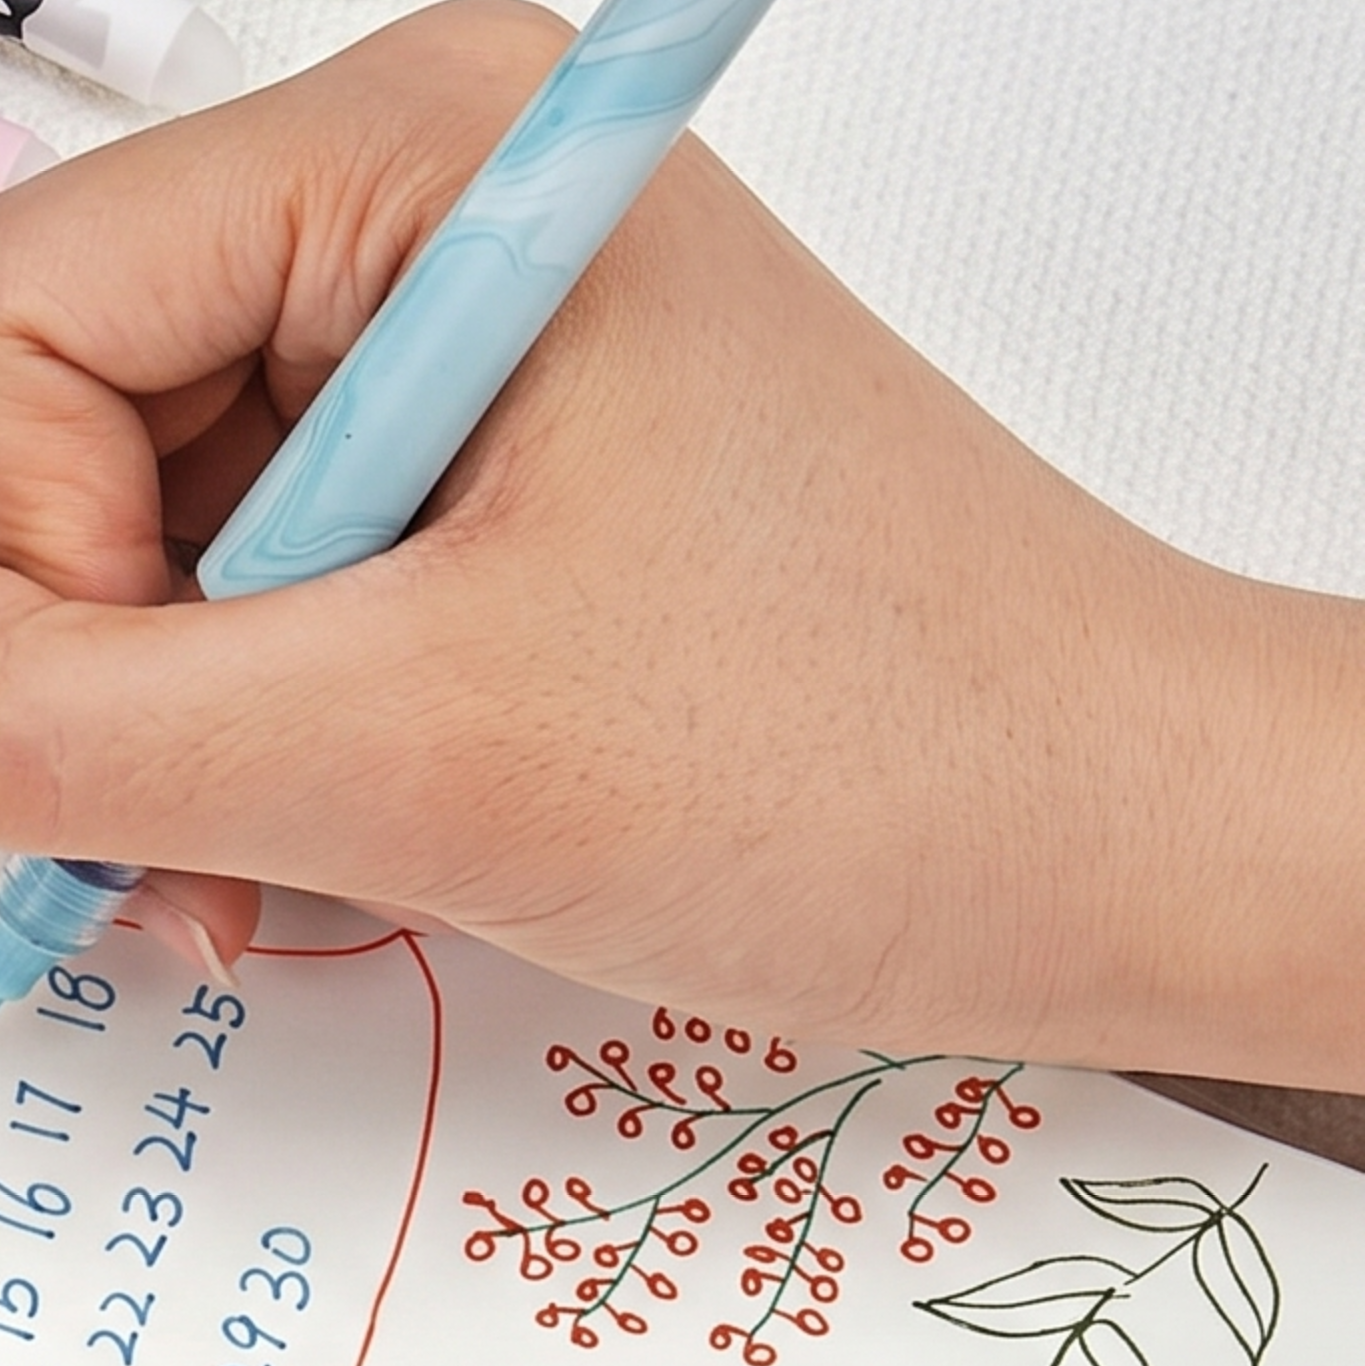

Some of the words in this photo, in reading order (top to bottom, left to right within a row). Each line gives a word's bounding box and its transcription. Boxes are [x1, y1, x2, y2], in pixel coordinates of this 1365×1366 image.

[36, 965, 116, 1032] 18
[173, 984, 246, 1071] 25
[9, 1080, 83, 1143] 17
[132, 1087, 211, 1173] 24
[104, 1186, 184, 1268] 23
[238, 1226, 312, 1312] 30
